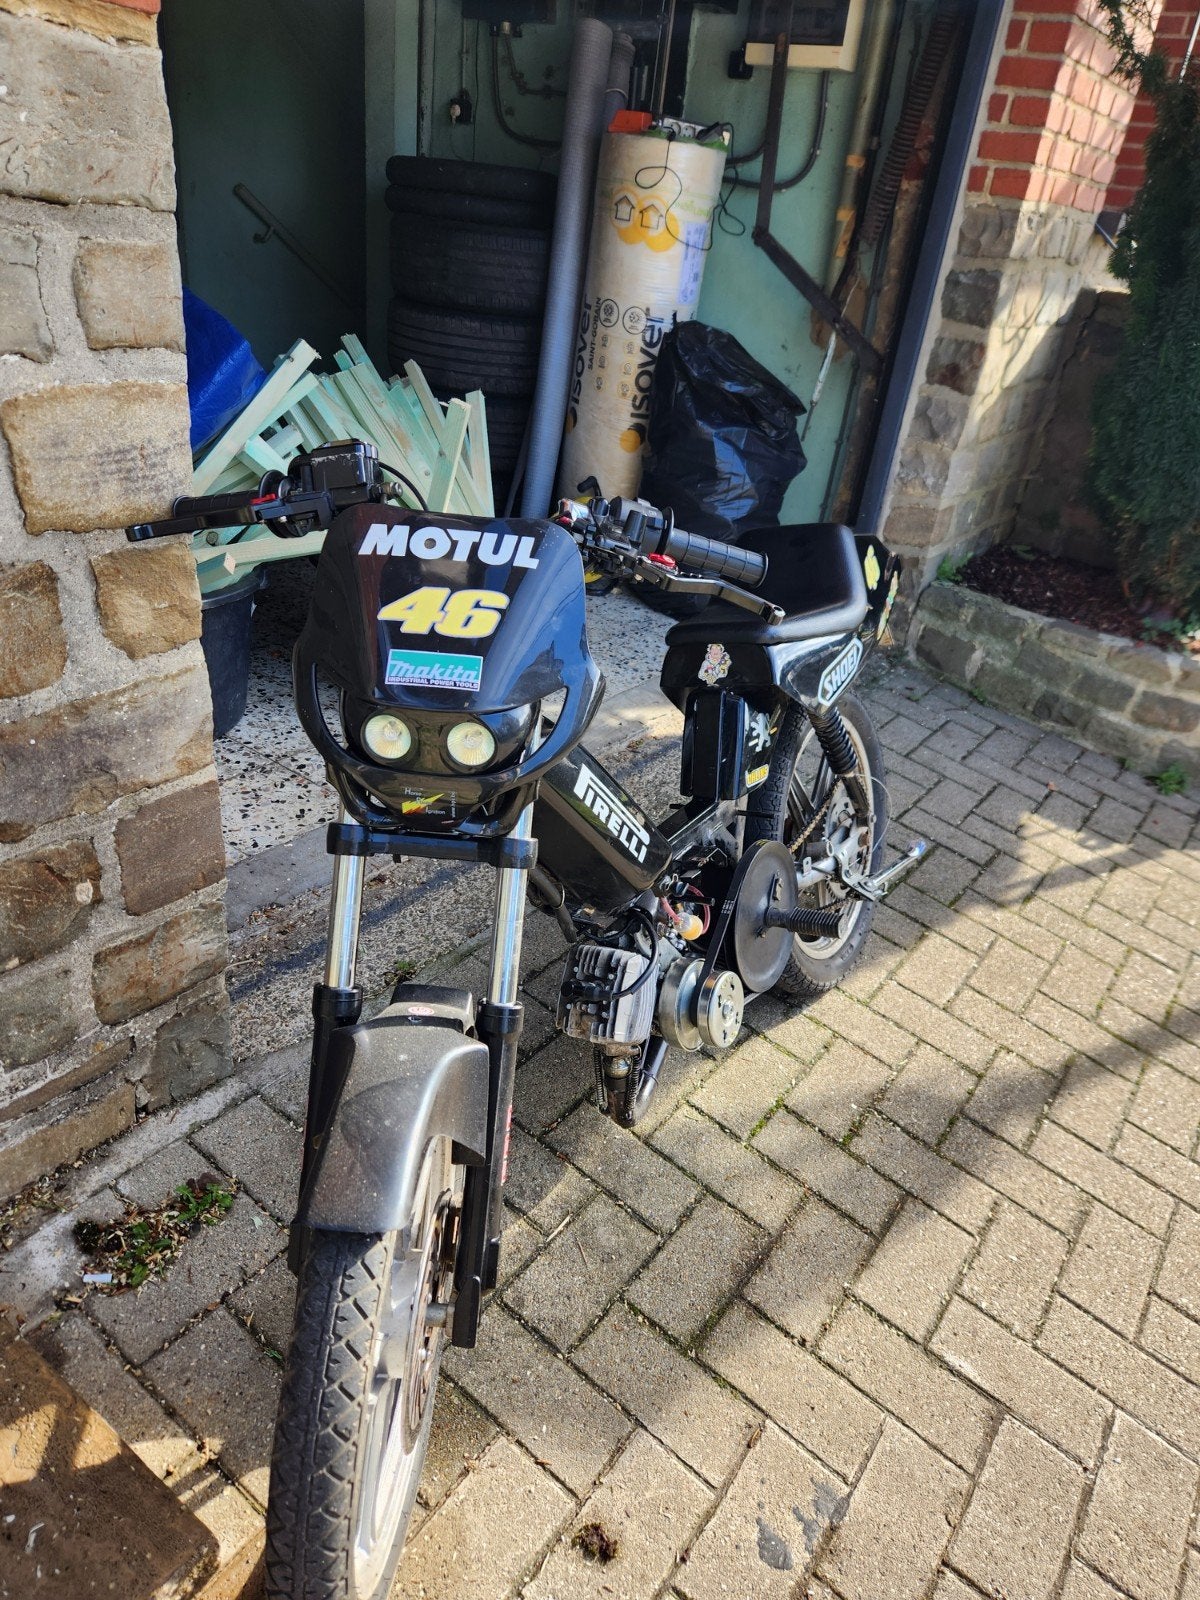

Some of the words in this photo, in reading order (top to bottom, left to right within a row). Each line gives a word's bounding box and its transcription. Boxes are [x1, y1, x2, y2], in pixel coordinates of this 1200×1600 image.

[588, 297, 602, 371] SAINT-GOBAIN
[358, 523, 540, 570] MOTUL
[376, 586, 510, 639] 46
[388, 676, 429, 684] INDUSTRIAL
[429, 679, 455, 687] POWER
[456, 681, 479, 689] TOOLS
[823, 644, 859, 700] SHOEI
[573, 764, 651, 864] PIRELLI
